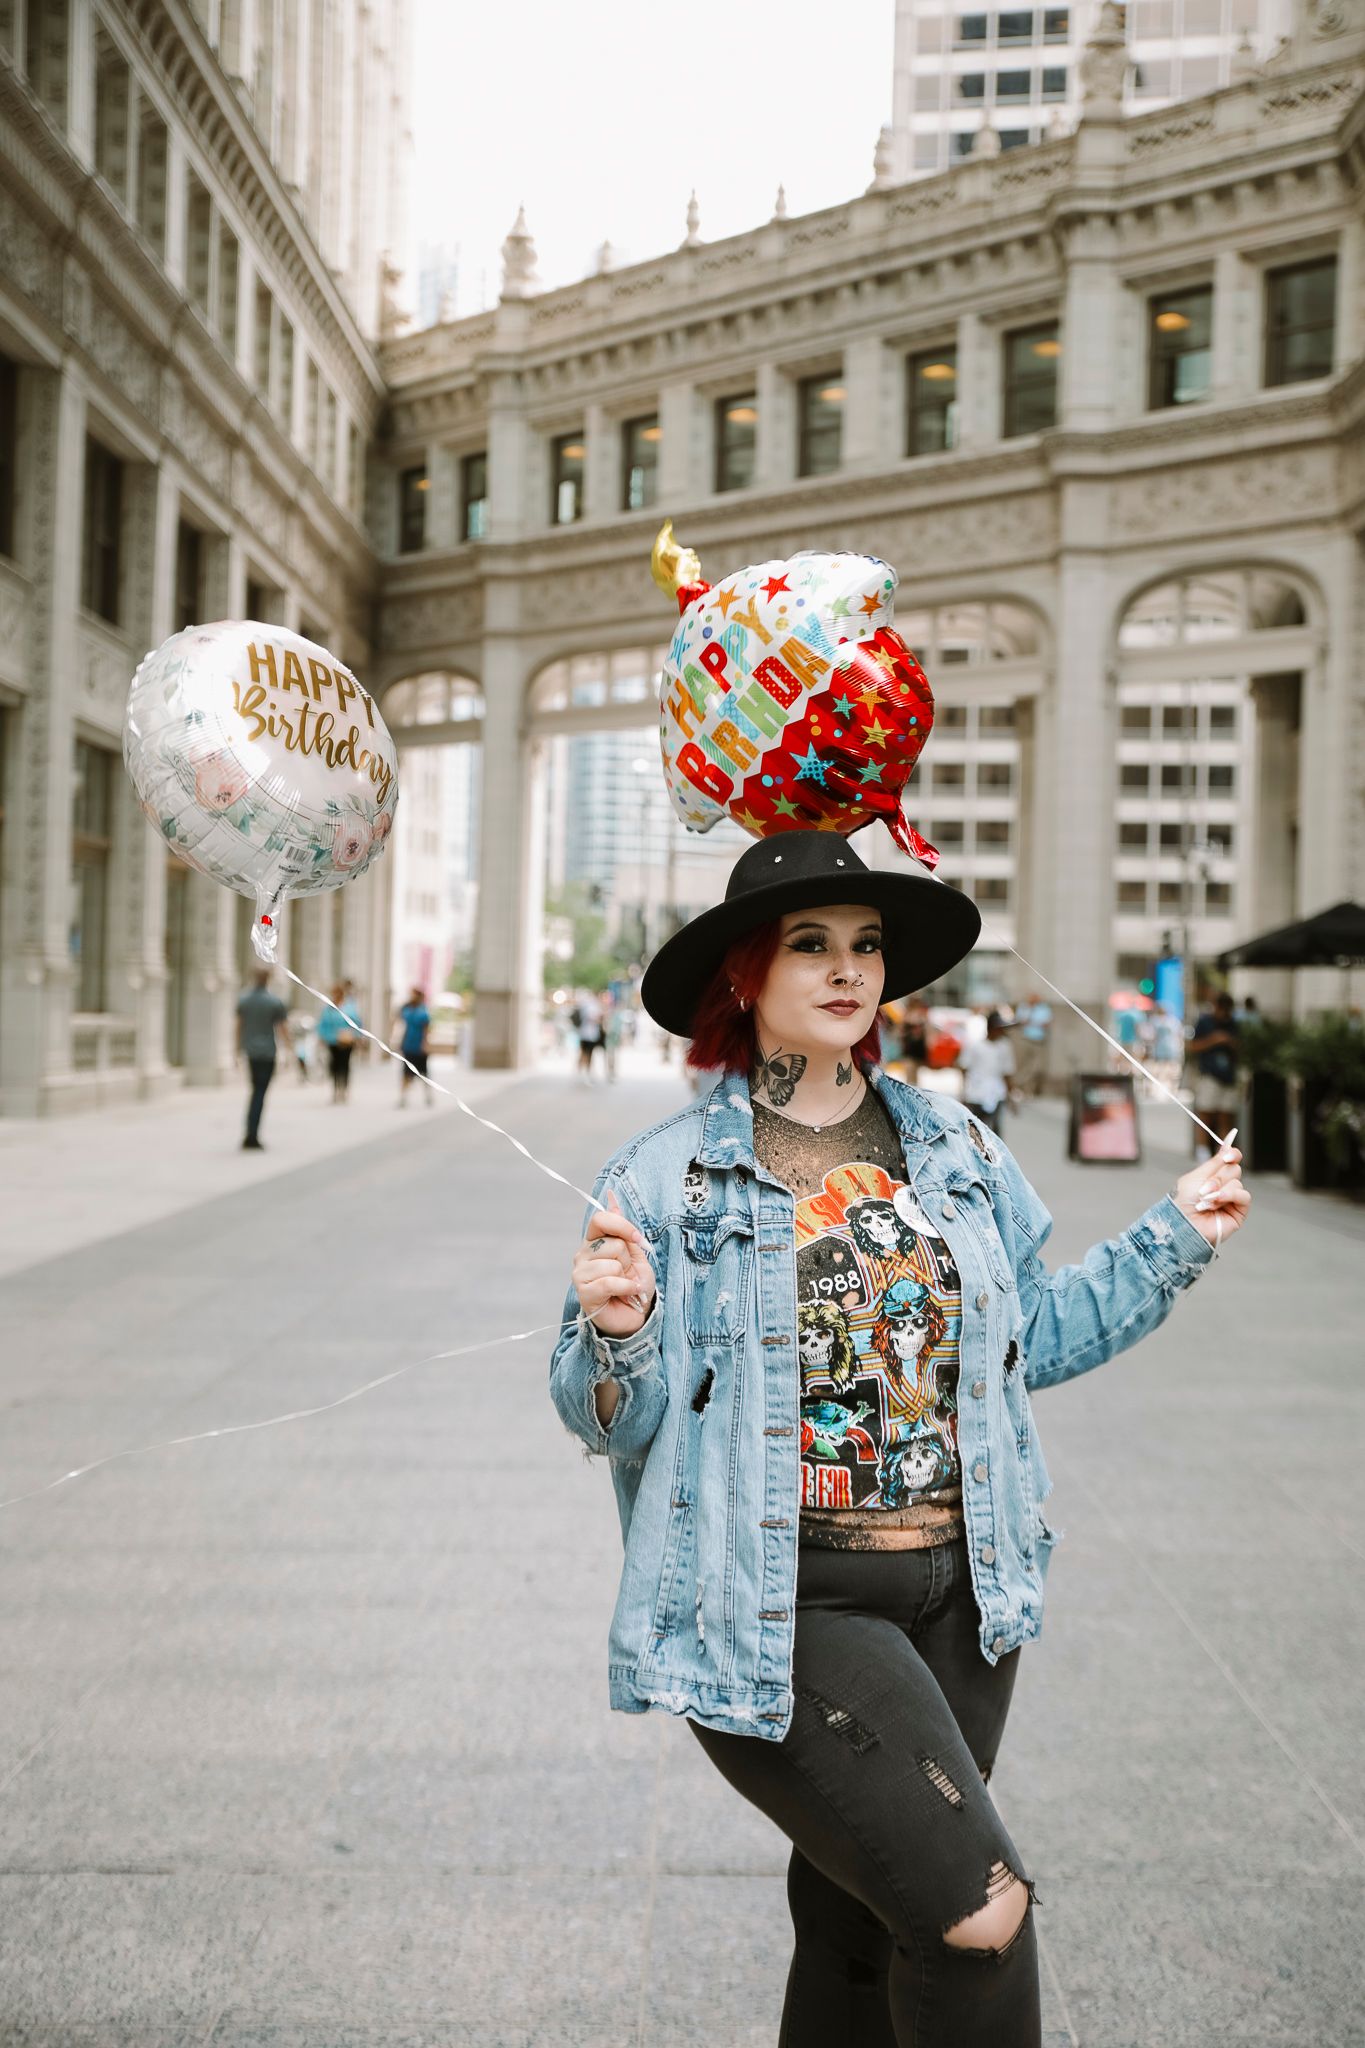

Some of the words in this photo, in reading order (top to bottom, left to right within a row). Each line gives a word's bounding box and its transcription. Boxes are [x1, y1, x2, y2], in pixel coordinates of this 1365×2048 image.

[246, 642, 375, 729] HAPPY
[667, 595, 774, 741] HAPPY
[676, 611, 838, 807] BIRTHDAY
[231, 681, 393, 805] Birthday
[809, 1270, 862, 1299] 1988
[816, 1465, 852, 1509] FOR
